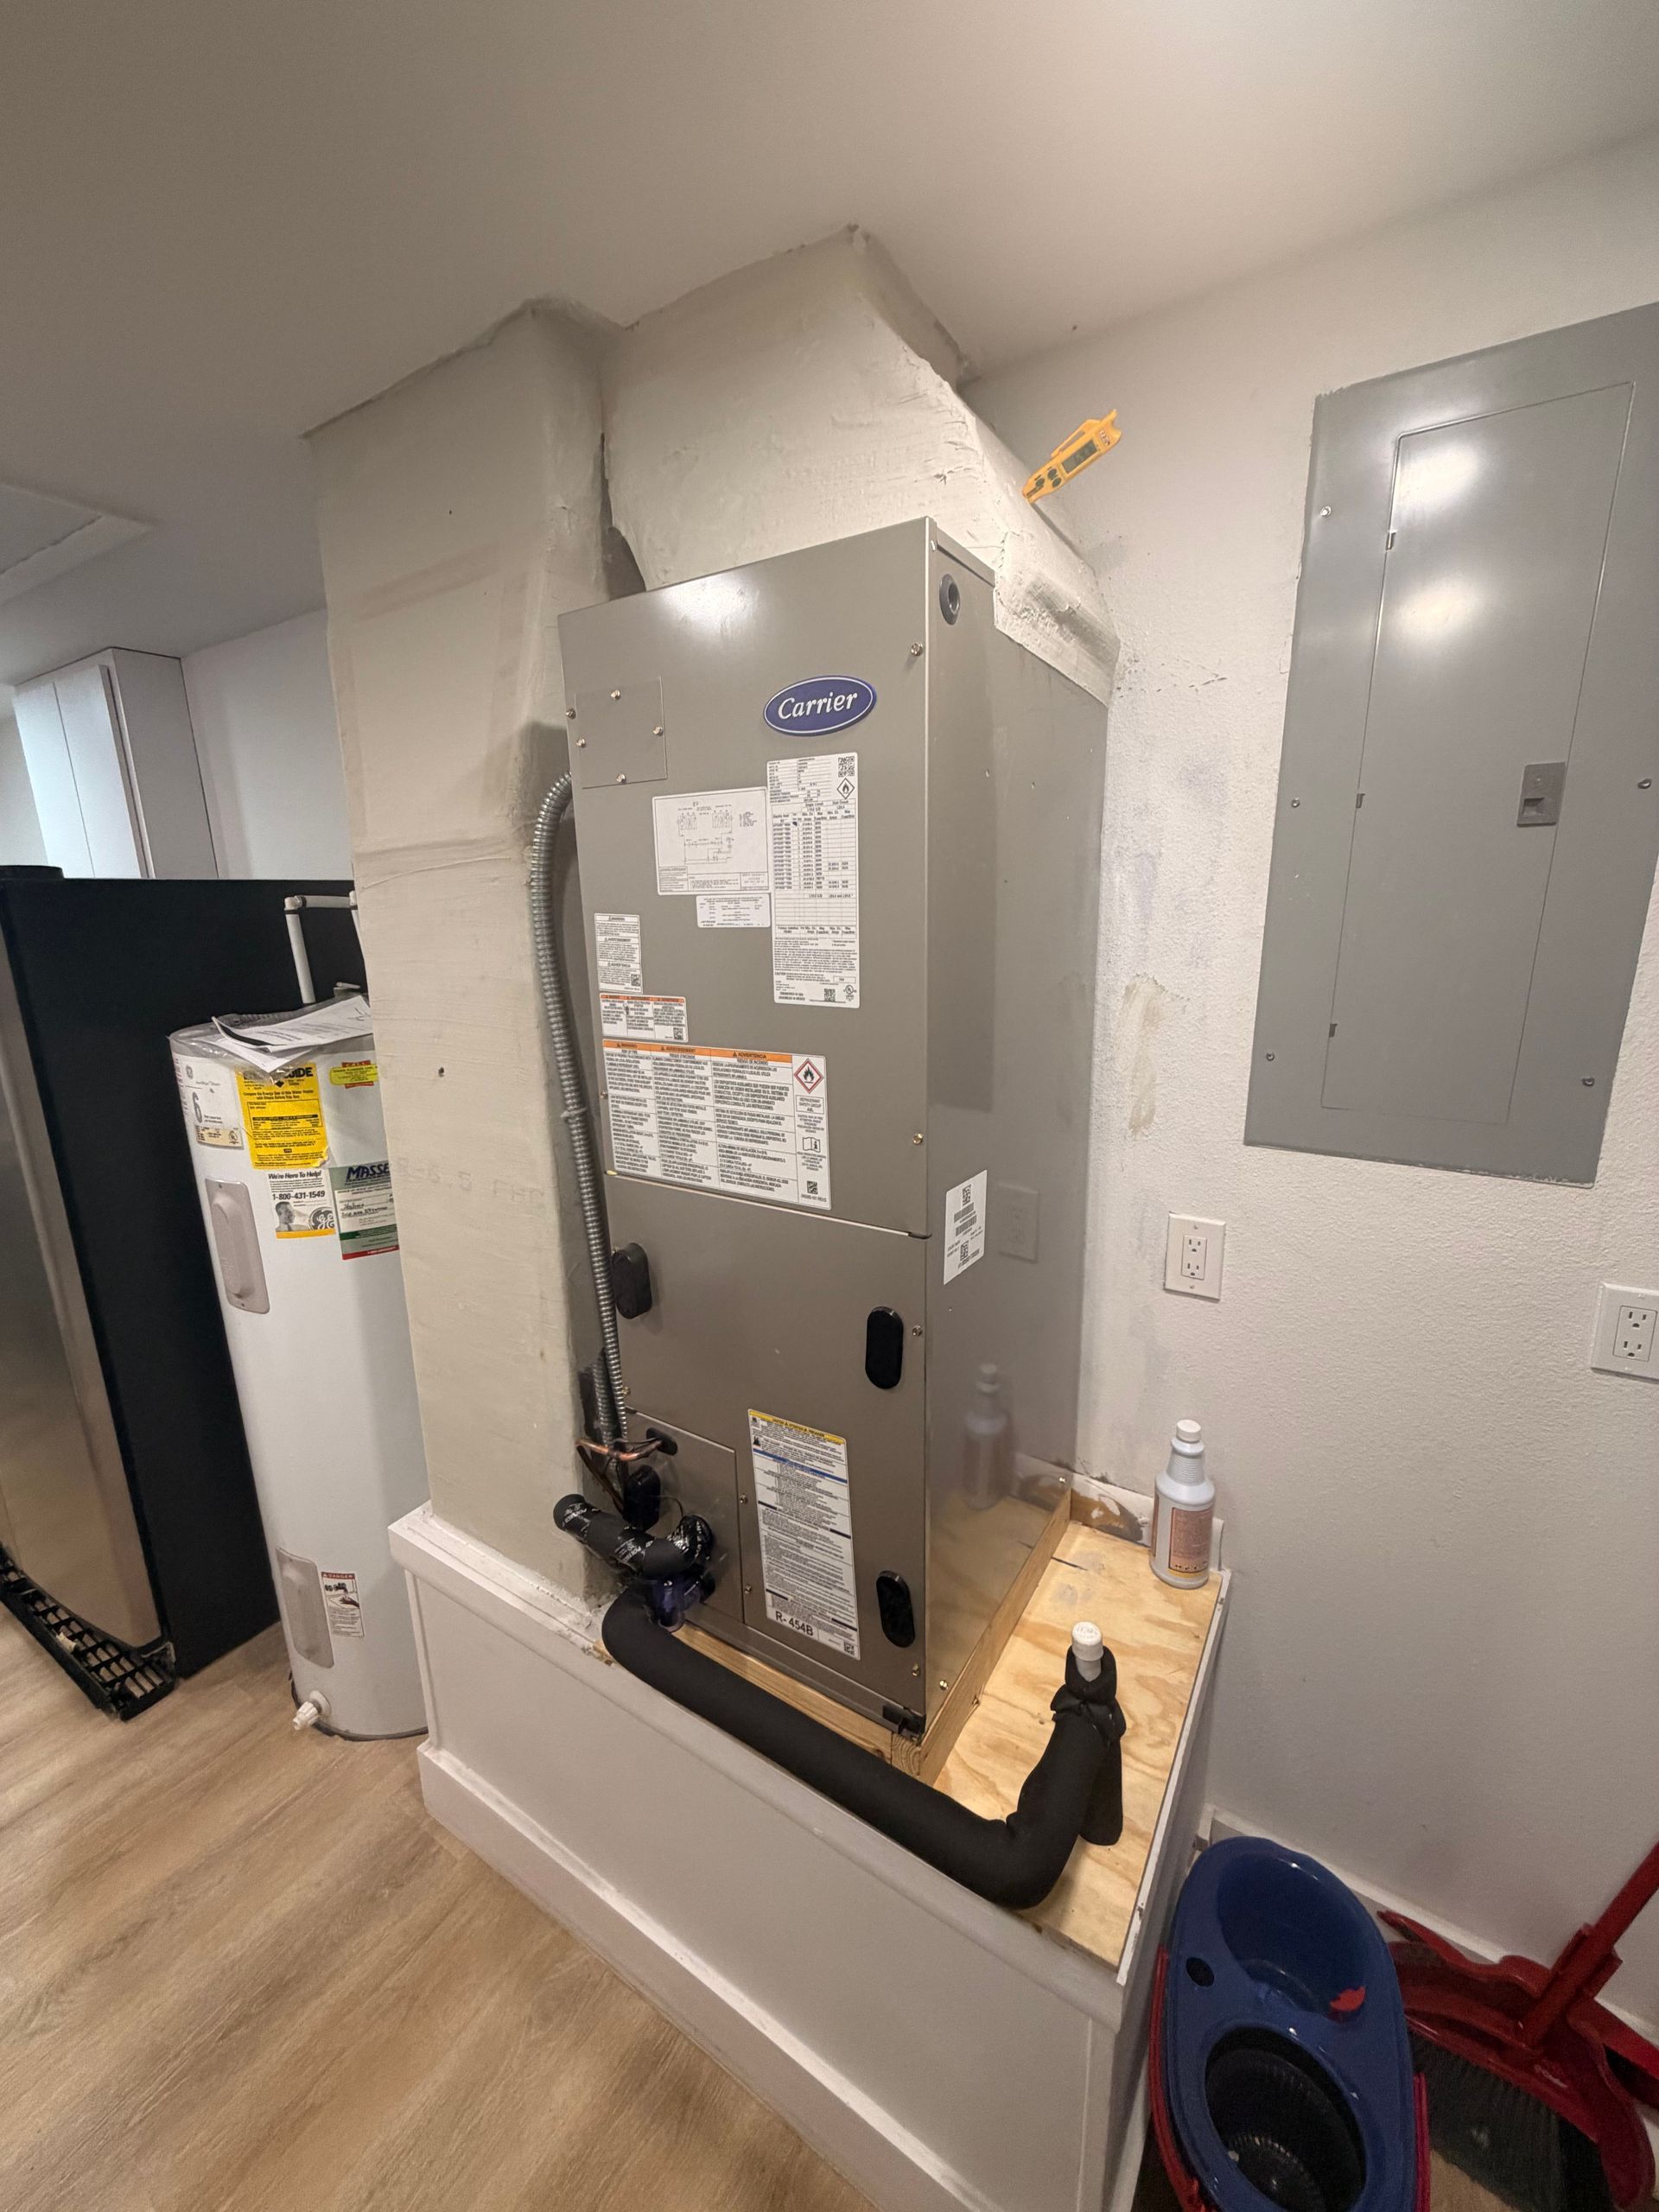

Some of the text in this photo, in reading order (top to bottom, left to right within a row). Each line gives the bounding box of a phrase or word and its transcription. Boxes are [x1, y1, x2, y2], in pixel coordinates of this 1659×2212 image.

[778, 691, 858, 720] Carrier
[307, 1170, 321, 1178] Help!
[272, 1191, 325, 1200] 1-800-431-1549
